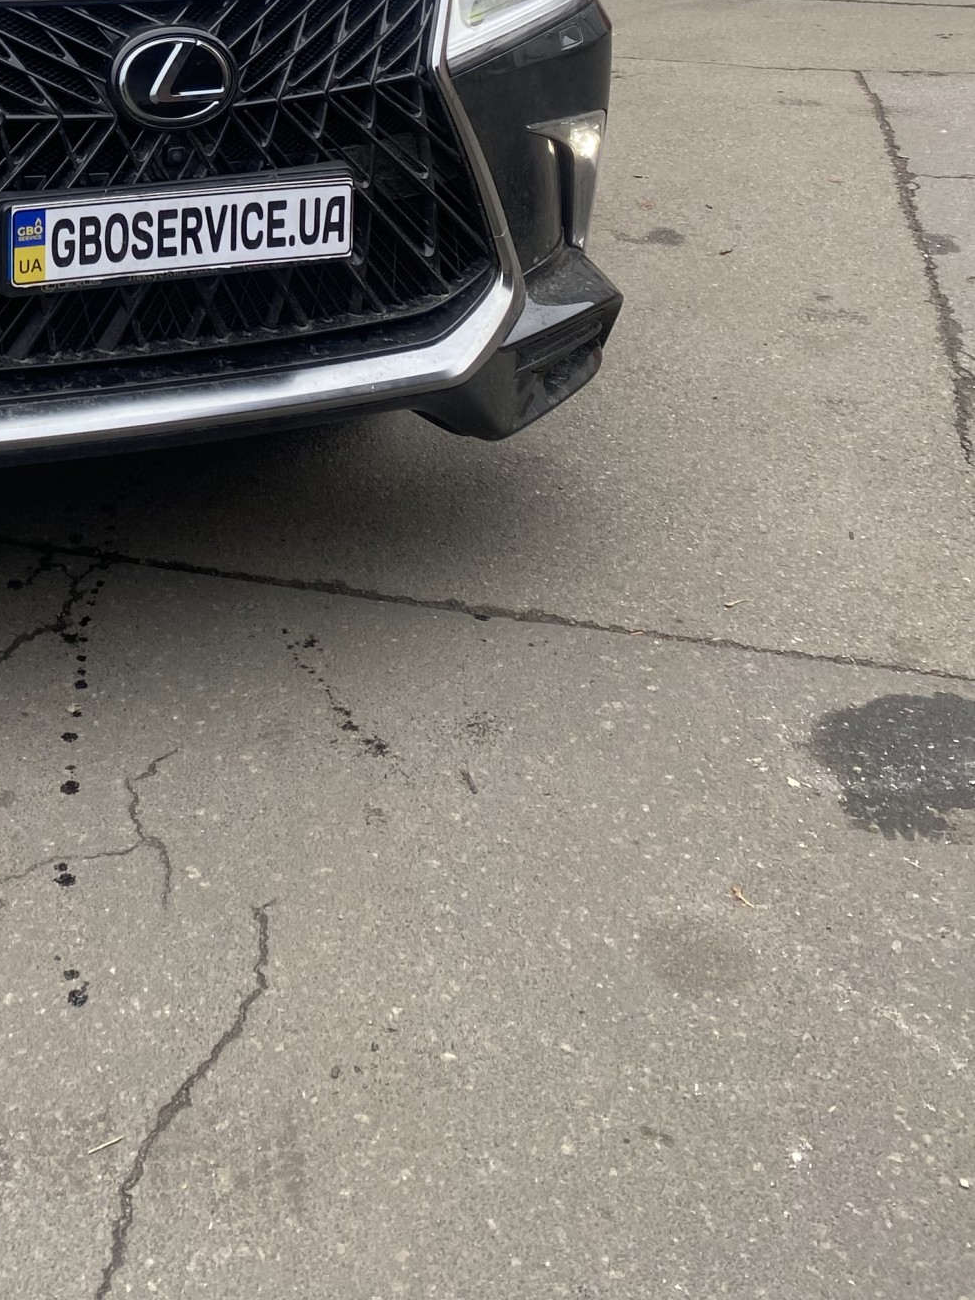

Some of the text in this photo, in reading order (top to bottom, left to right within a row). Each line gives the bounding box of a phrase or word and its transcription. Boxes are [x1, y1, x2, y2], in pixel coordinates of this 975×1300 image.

[17, 225, 43, 236] GBO
[51, 195, 346, 268] GBOSERVICE.UA
[19, 258, 42, 274] UA
